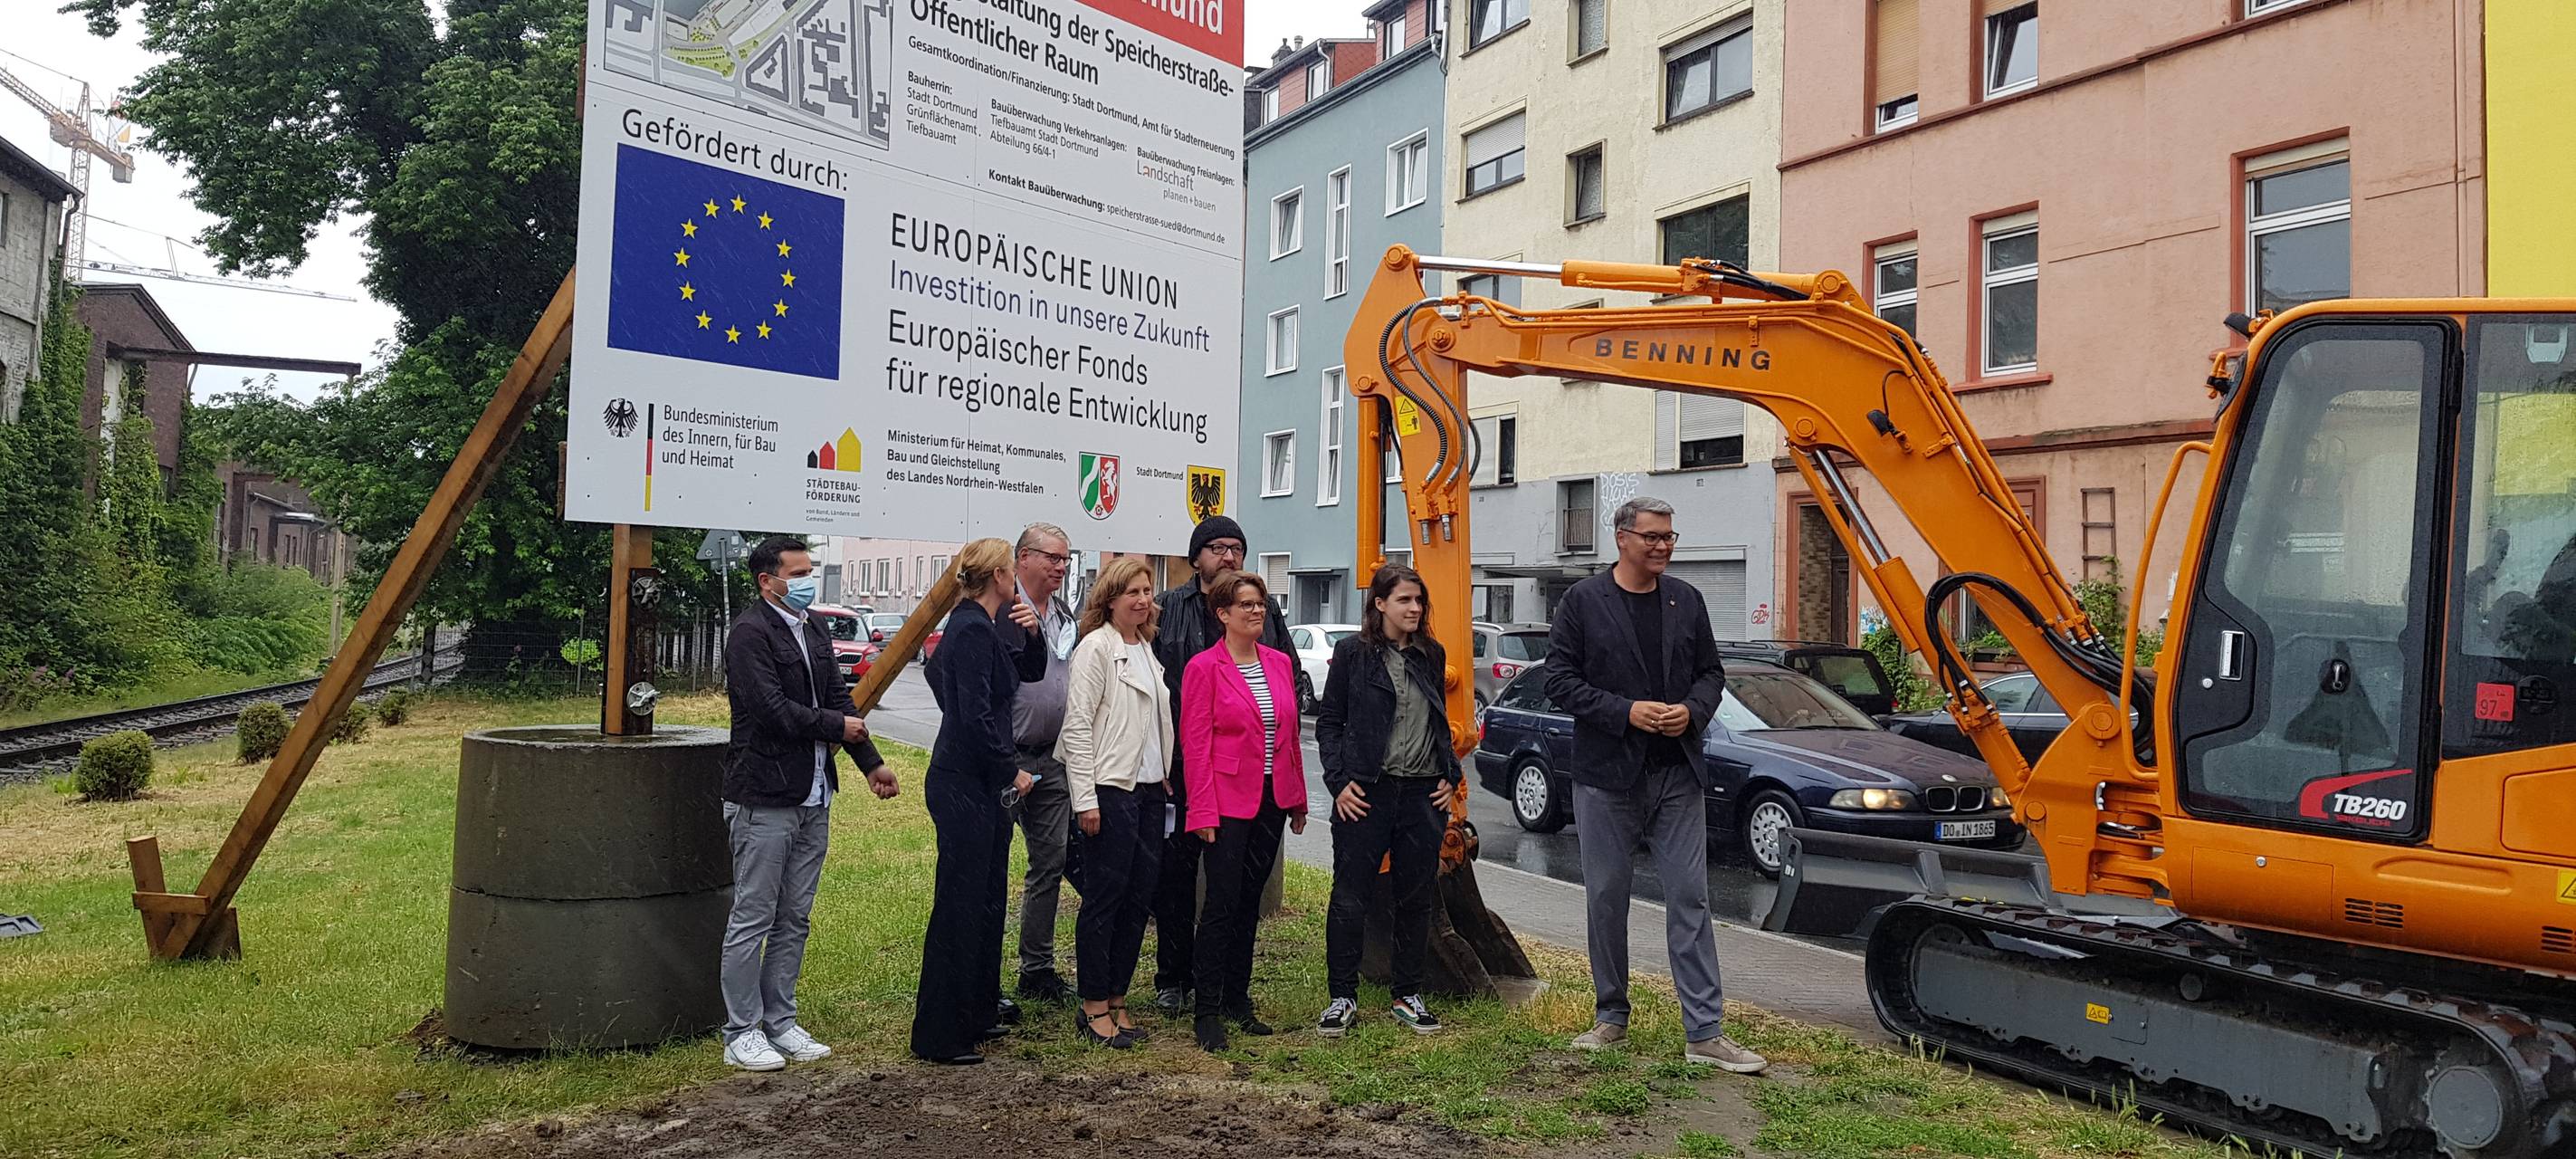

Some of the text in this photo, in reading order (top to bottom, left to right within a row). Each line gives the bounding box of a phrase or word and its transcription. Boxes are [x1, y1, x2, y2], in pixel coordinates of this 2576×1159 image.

[1045, 43, 1099, 85] Raum
[1068, 14, 1099, 46] der
[1105, 29, 1234, 97] Speicherstraße-
[909, 71, 952, 95] Bauherrin:
[909, 35, 1235, 160] Gesamtkoordination/Finanzierung: Stadt Dortmund, Amt für Stadterneuerung
[907, 87, 978, 119] Stadt Dortmund
[906, 120, 957, 145] Tiefbauamt
[990, 114, 1099, 158] Tiefbauamt Stadt Dortmund
[991, 99, 1127, 152] Bauüberwachung Verkehrsanlagen:
[623, 109, 847, 191] Gefördert durch:
[990, 130, 1055, 159] Abteilung 66/4-1
[1137, 147, 1235, 187] Bauüberwachung Freianlagen:
[1137, 160, 1194, 191] Landschaft
[988, 168, 1225, 244] Kontakt Bauüberwachung: speicherstrasse-sued@dortmund.de
[892, 213, 1178, 310] EUROPÄISCHE UNION
[891, 259, 1210, 352] Investition in unsere Zukunft
[889, 309, 1148, 385] Europäischer Fonds
[1595, 339, 1770, 370] BENNING
[886, 358, 1207, 444] für regionale Entwicklung
[663, 405, 778, 432] Bundesministerium
[663, 426, 776, 452] des Innern, für Bau
[888, 430, 1066, 463] Ministerium für Heimat, Kommunales,
[662, 449, 734, 469] und Heimat
[887, 449, 1000, 474] Bau und Gleichstellung
[1136, 466, 1183, 481] Stadt Dortmund
[806, 477, 861, 491] STÄDTEBAU-
[806, 489, 861, 503] FÖRDERUNG
[887, 468, 1044, 494] des Landes Nordrhein-Westfalen
[2334, 793, 2407, 820] TB260
[1943, 822, 1993, 837] DO IN 1865
